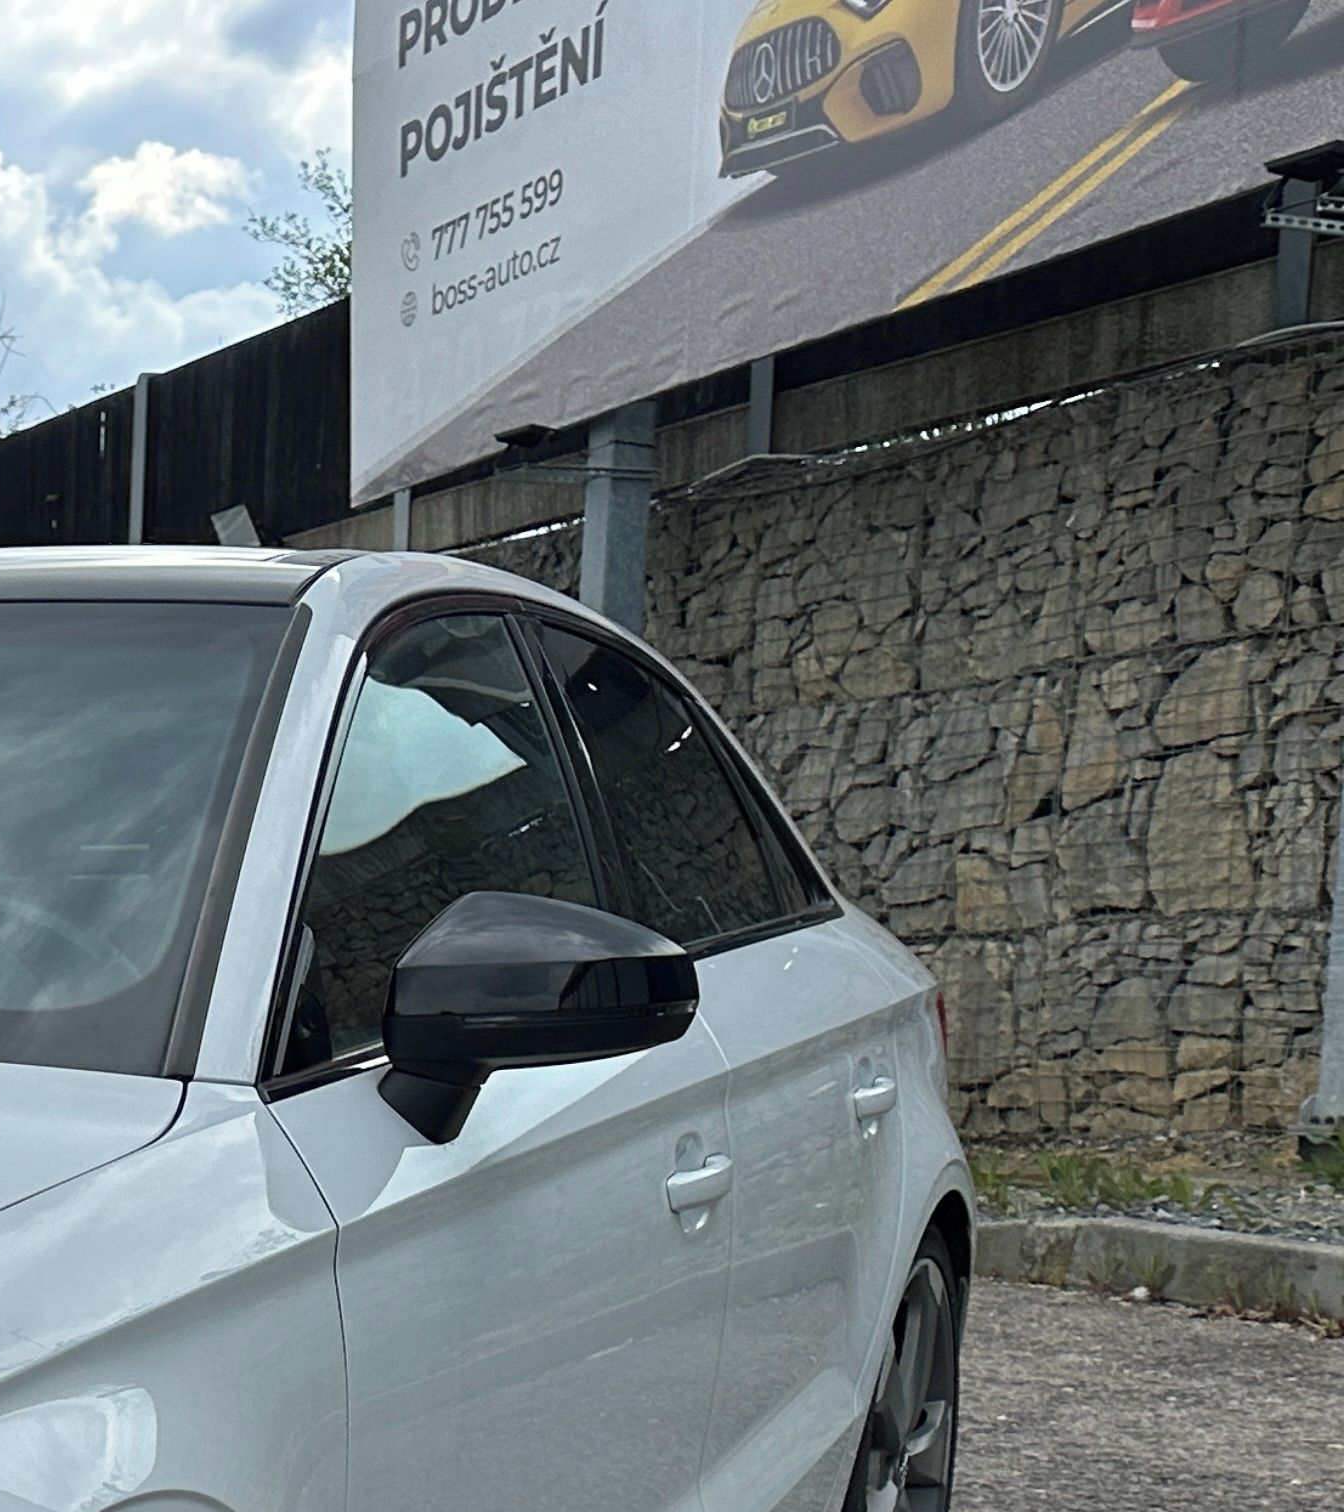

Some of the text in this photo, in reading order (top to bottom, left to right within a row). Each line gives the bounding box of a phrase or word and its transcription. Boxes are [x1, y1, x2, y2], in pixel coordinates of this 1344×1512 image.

[400, 0, 608, 178] POJIŠTĚNÍ
[432, 169, 563, 260] 777 755 599
[432, 236, 561, 315] boss-auto.cz
